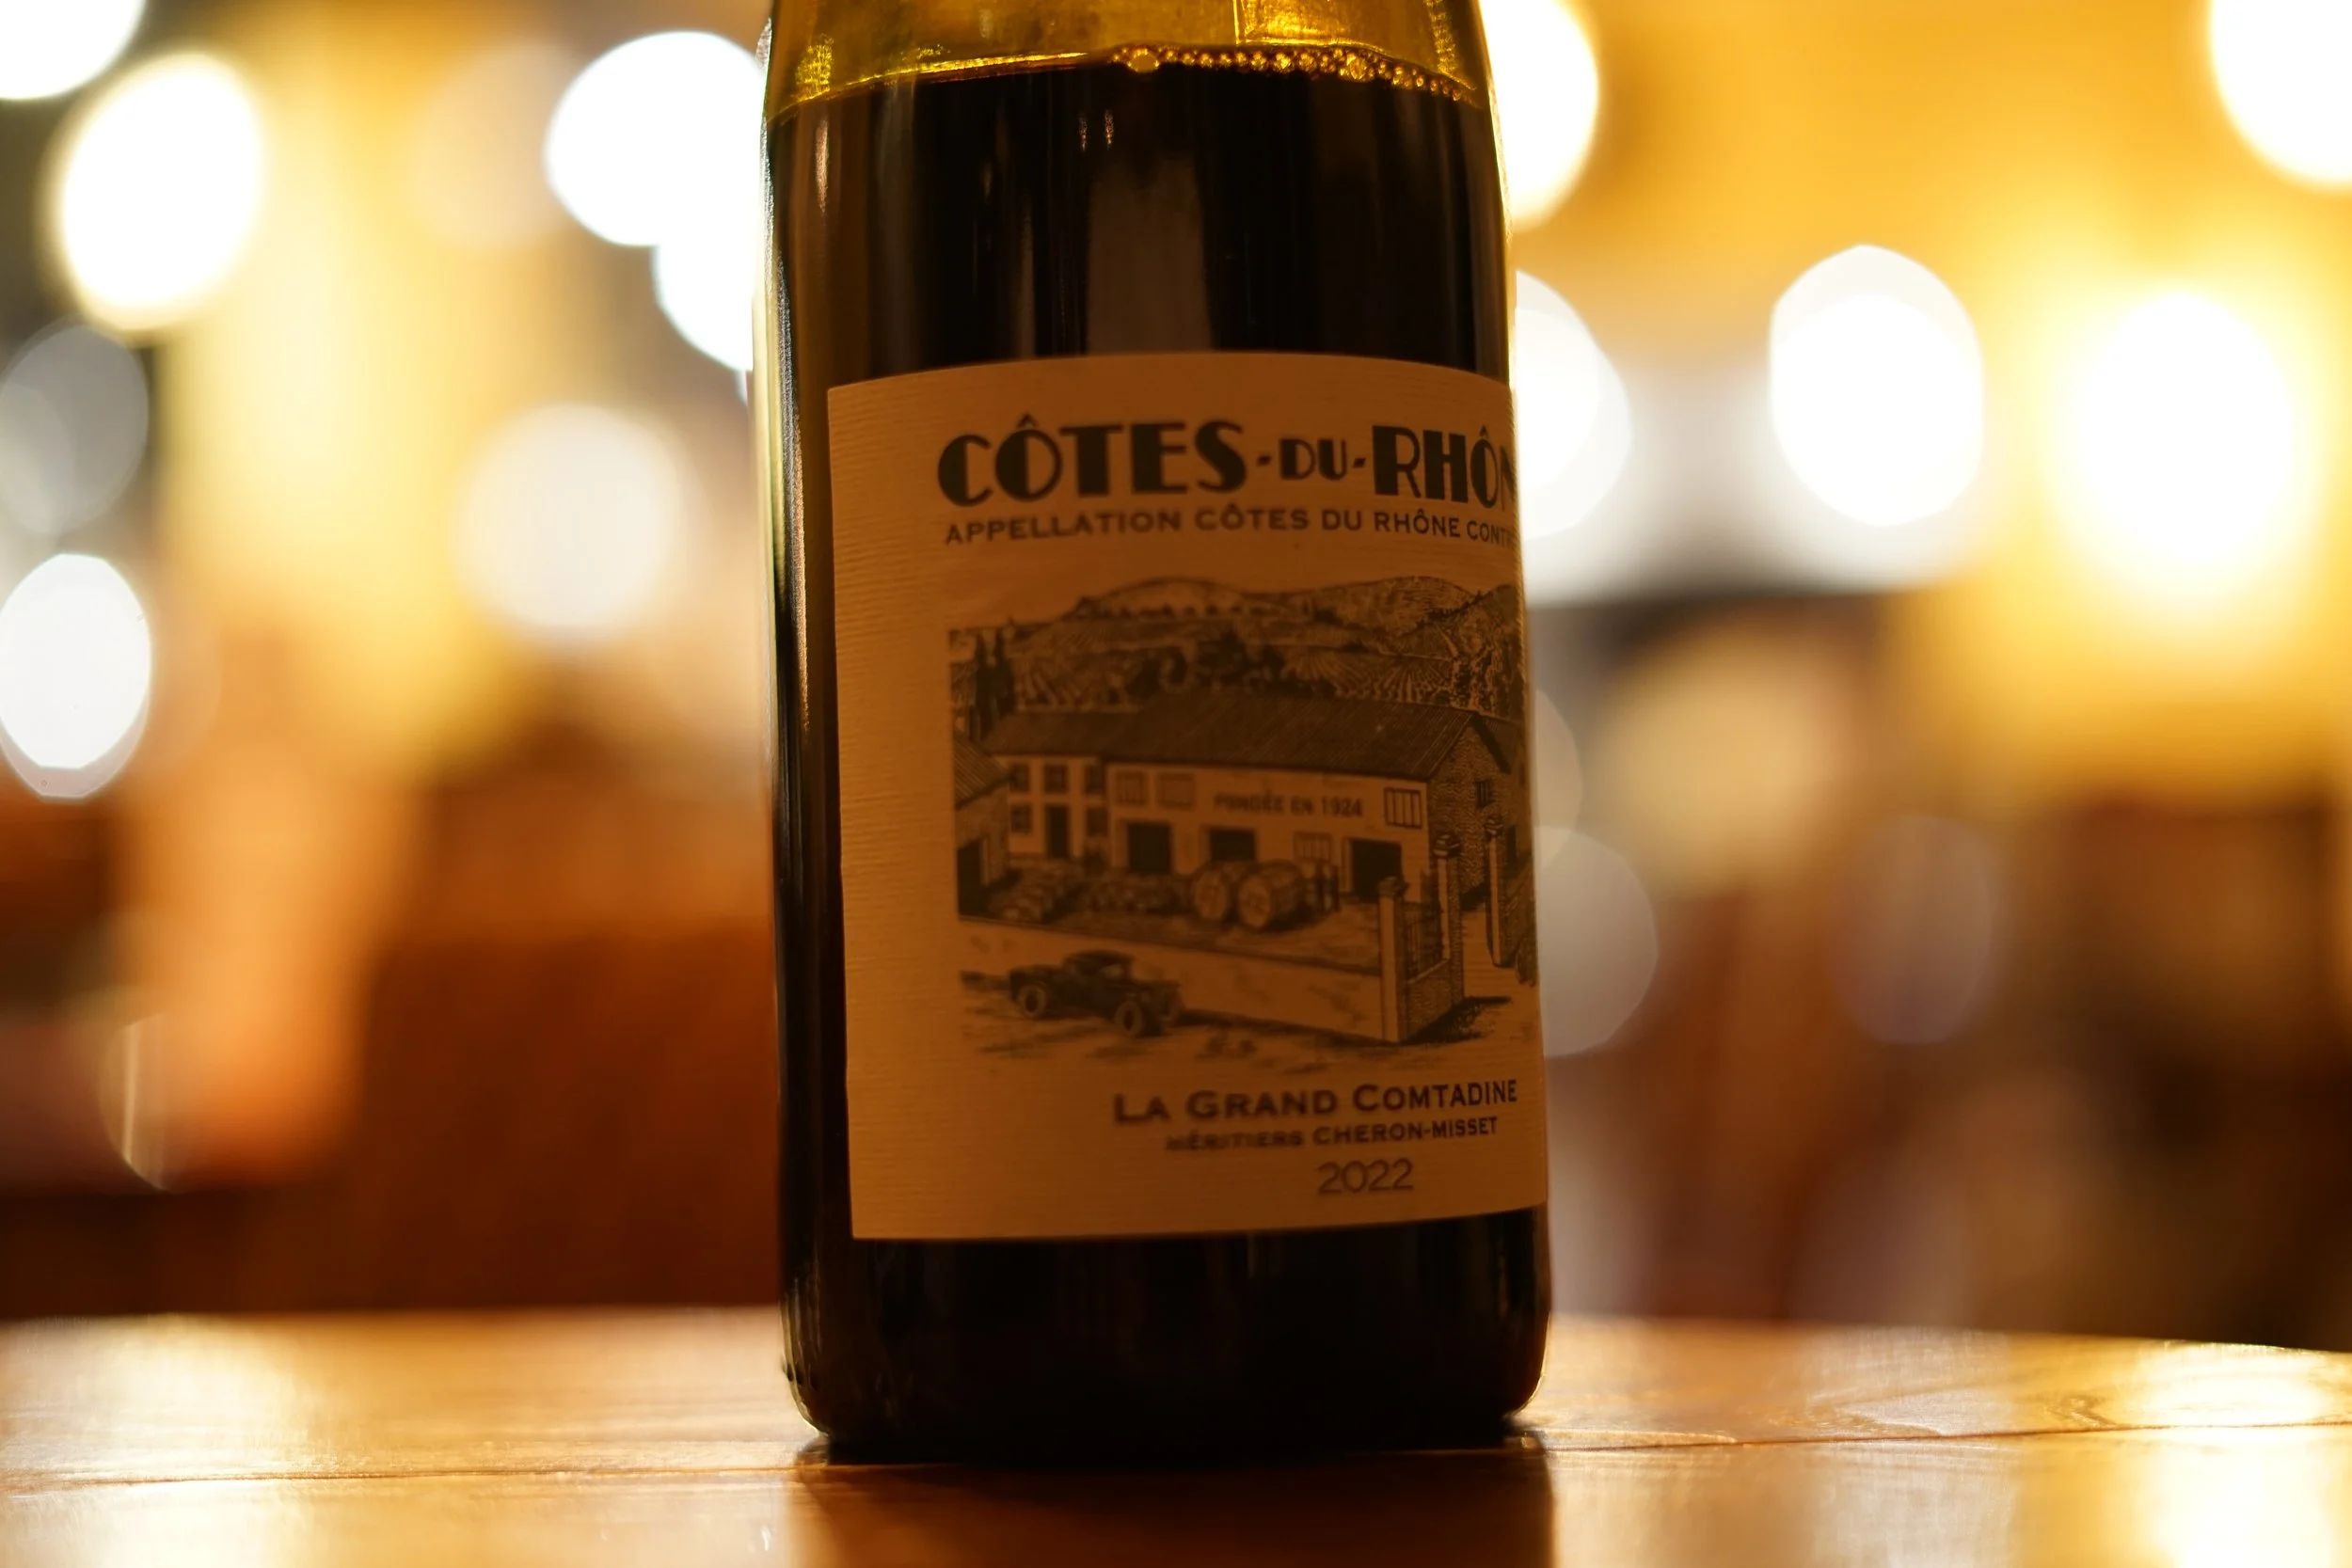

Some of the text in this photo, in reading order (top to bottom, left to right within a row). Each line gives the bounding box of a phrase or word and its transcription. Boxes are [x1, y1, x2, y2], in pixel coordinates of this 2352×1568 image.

[946, 510, 1181, 545] APPELLATION
[1195, 503, 1310, 532] CÔTES
[1322, 509, 1362, 531] DU
[1375, 509, 1461, 538] RHÔNE
[1321, 796, 1362, 816] 1924
[1113, 1079, 1518, 1125] LA GRAND COMTADINE
[1313, 1117, 1498, 1146] CHERON-MISSET
[1318, 1158, 1414, 1194] 2022
